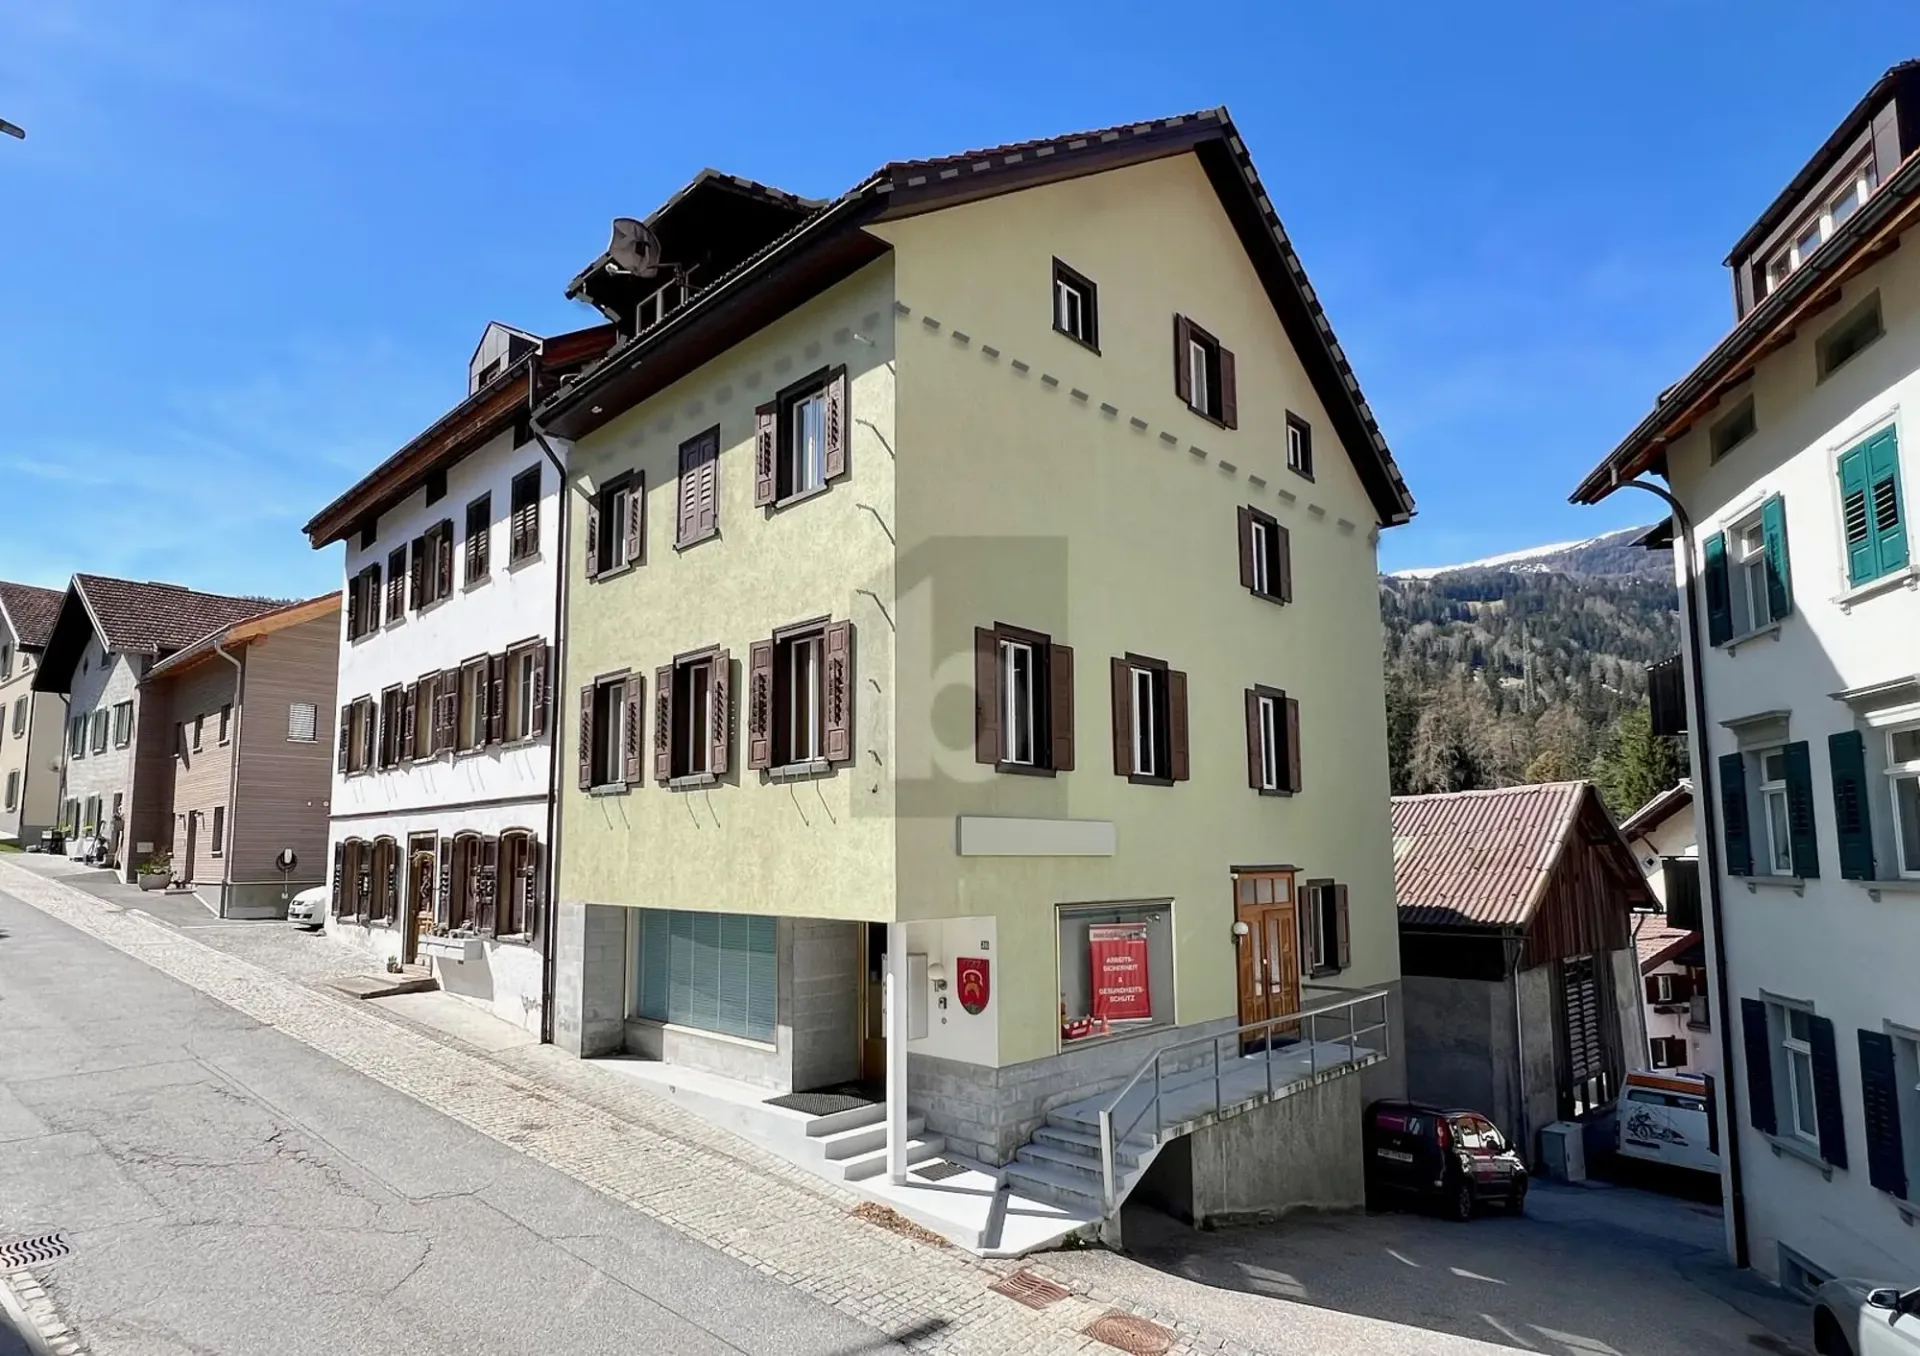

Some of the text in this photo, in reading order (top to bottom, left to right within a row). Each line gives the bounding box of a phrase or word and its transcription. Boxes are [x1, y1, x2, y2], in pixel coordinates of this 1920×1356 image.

[1106, 956, 1134, 964] ARBEITS-
[1103, 963, 1138, 972] SICHERHEIT
[1098, 986, 1145, 995] GESUNDHEITS-
[1110, 995, 1135, 1003] SCHUTZ
